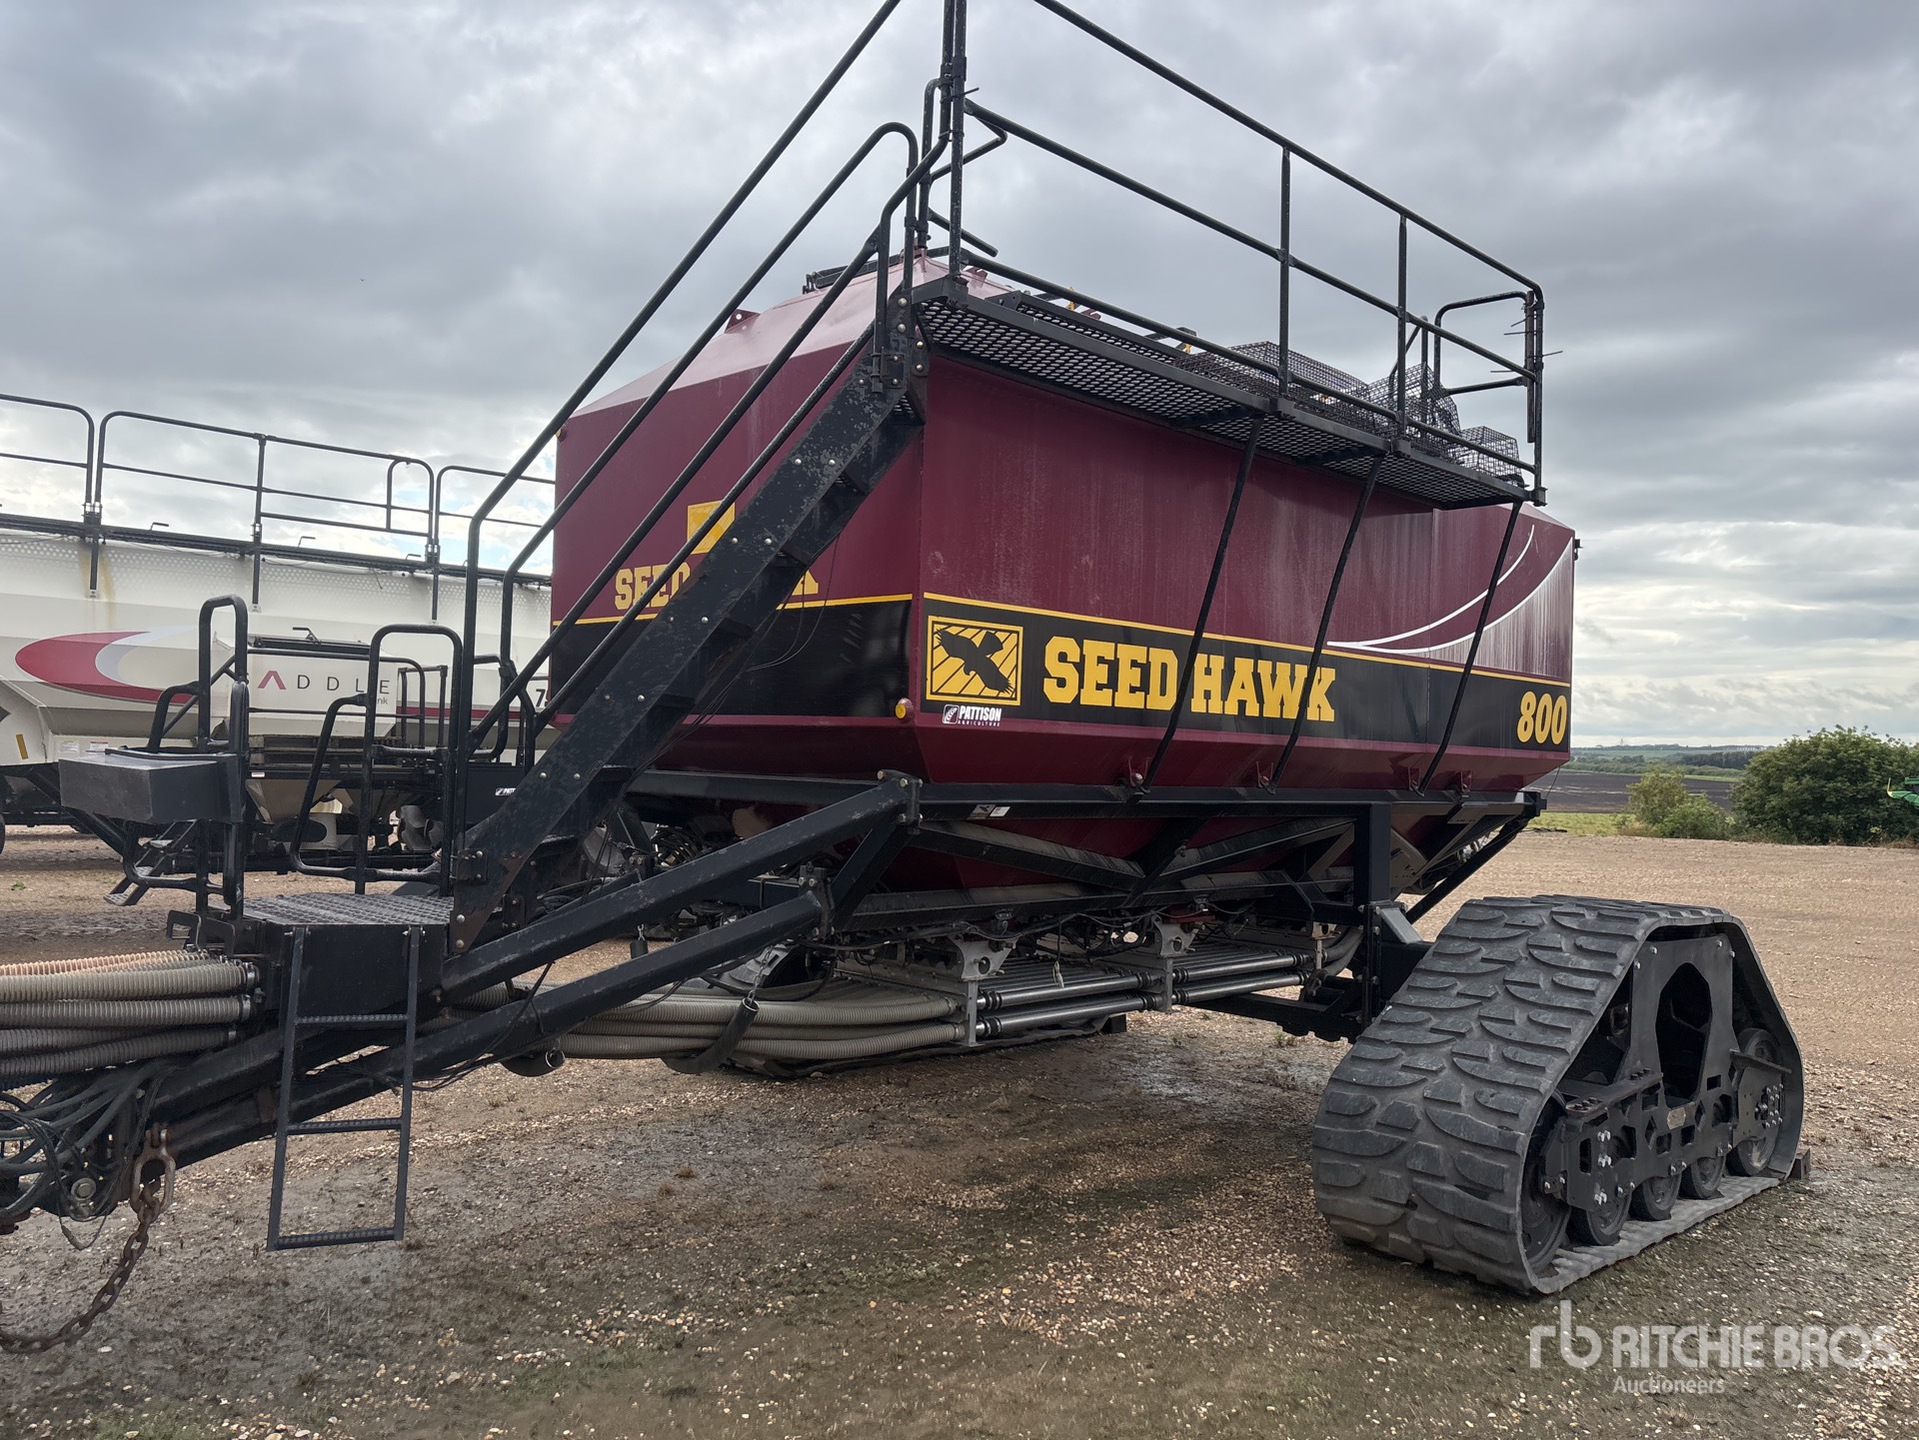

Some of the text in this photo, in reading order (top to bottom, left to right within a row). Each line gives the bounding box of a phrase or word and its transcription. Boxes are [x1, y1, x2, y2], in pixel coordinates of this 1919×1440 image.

[1043, 635, 1336, 722] SEED HAWK
[958, 705, 1002, 722] PATTISON
[1517, 691, 1567, 745] 800
